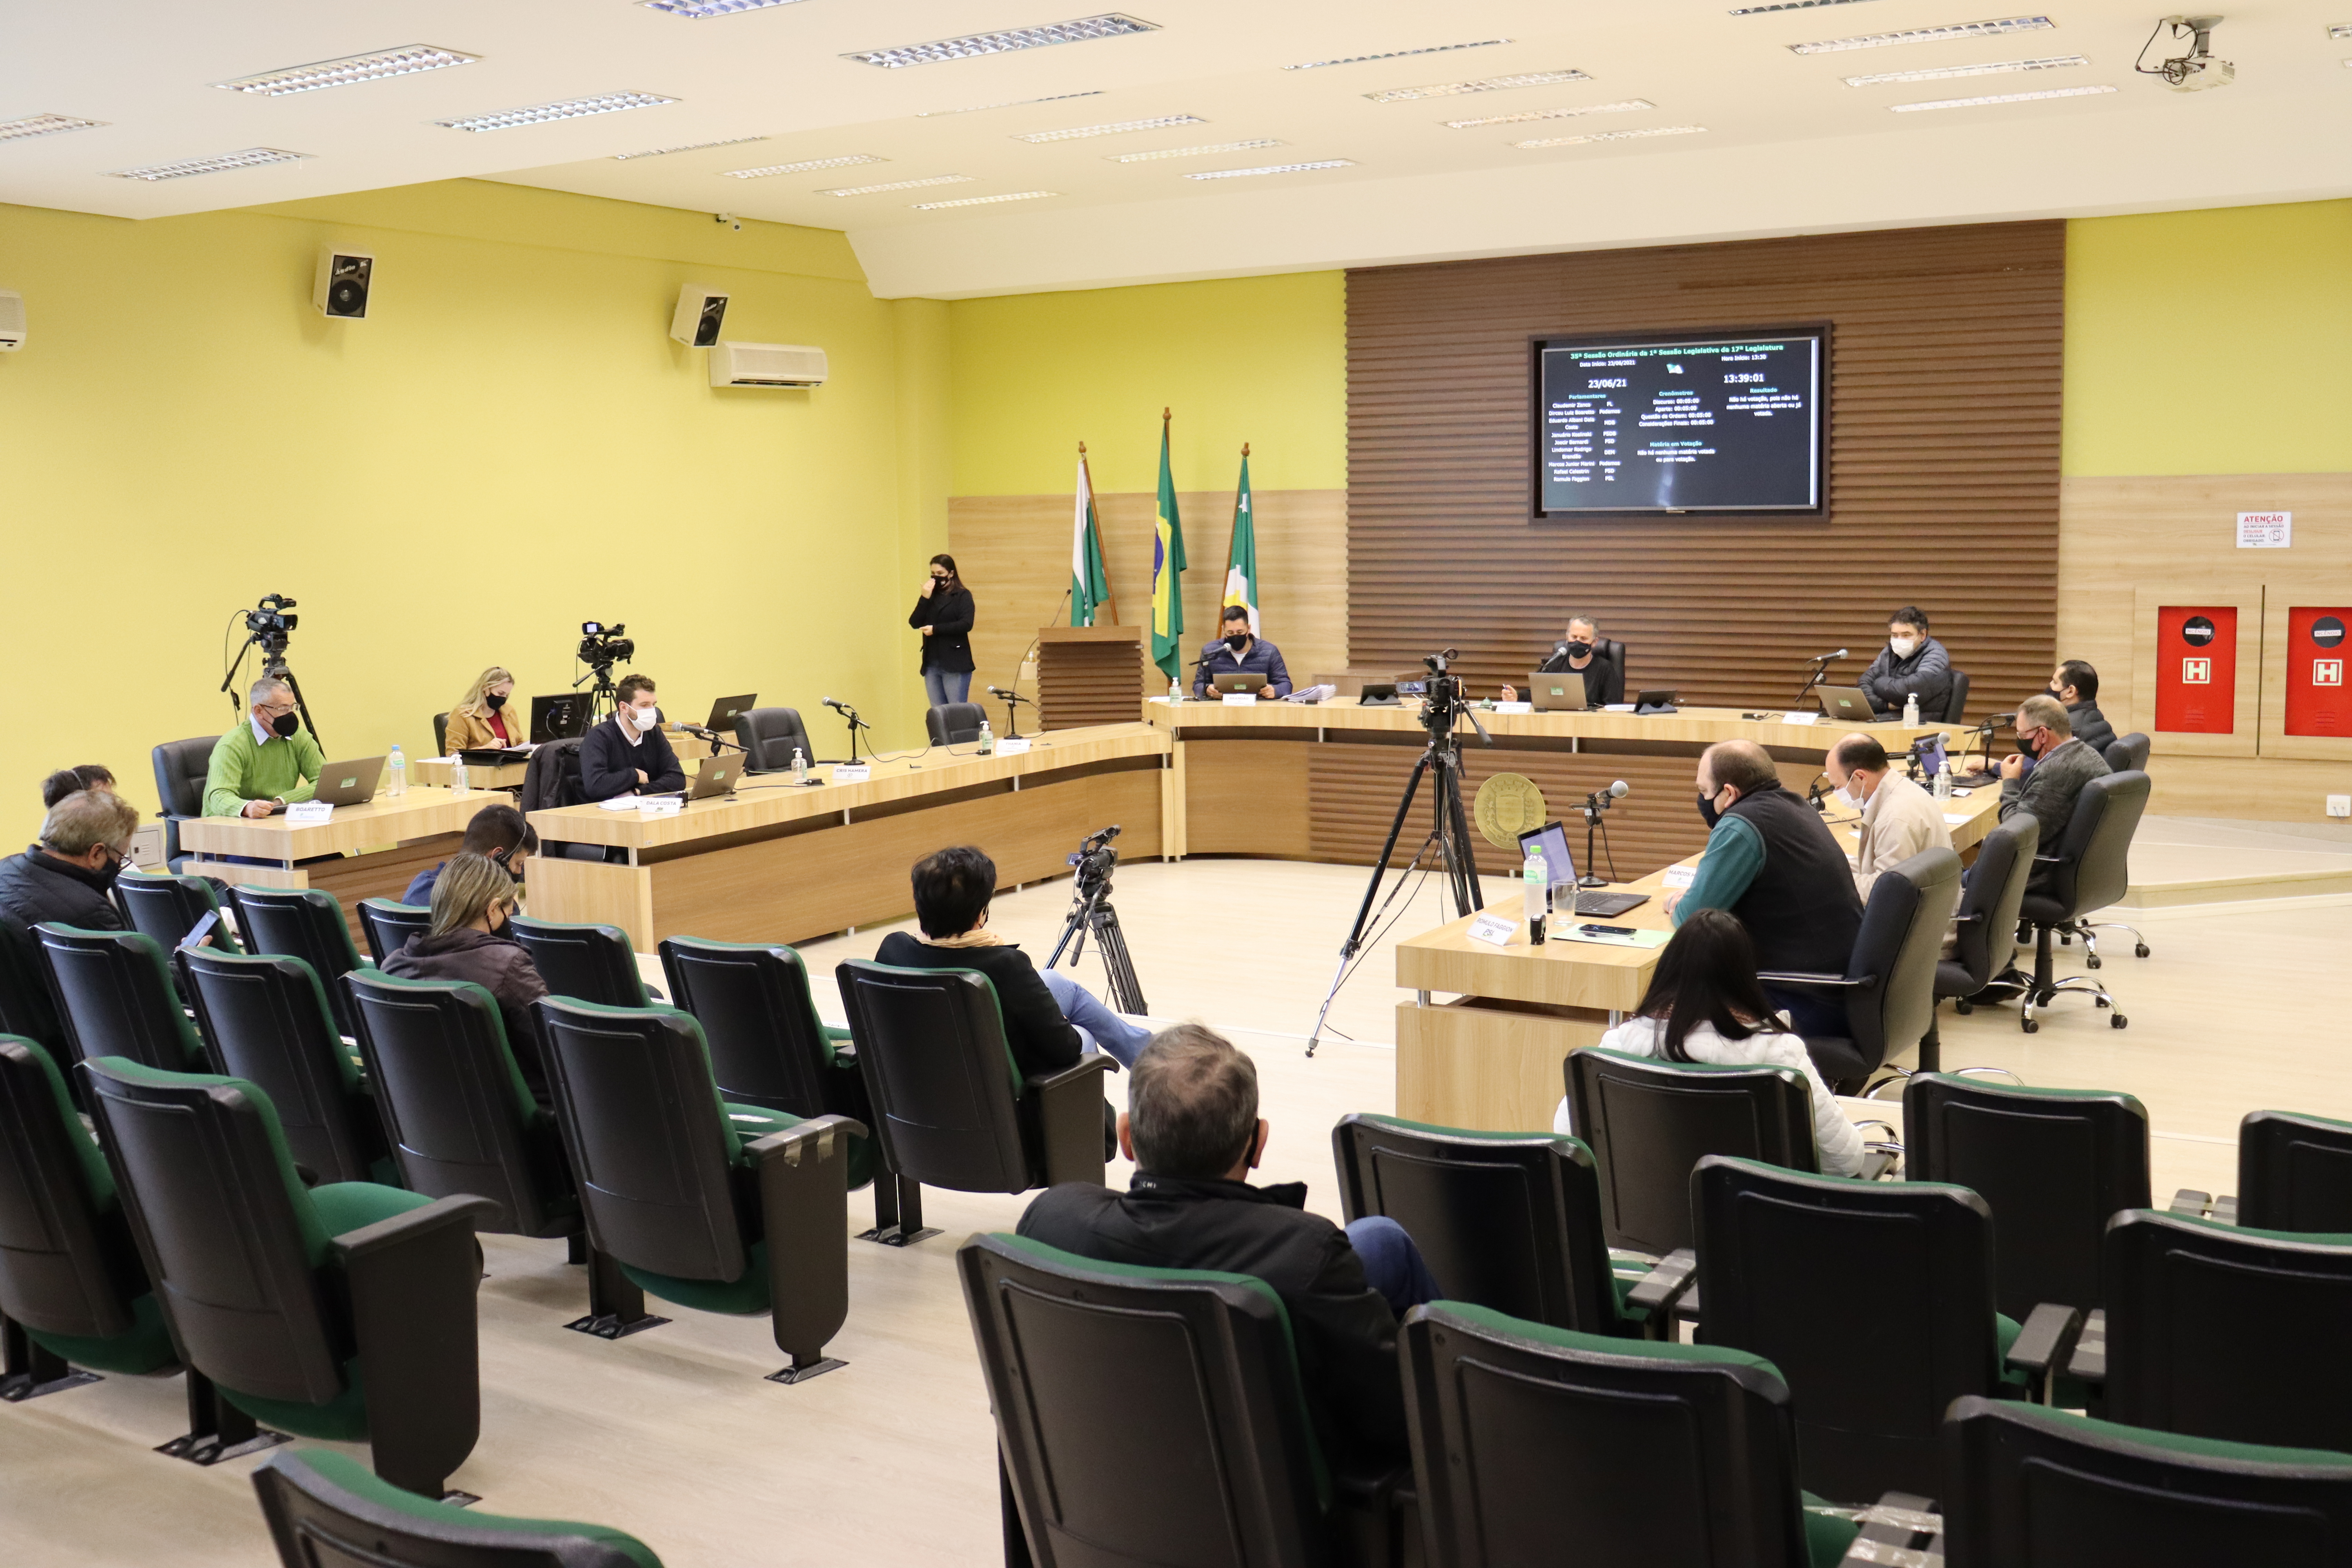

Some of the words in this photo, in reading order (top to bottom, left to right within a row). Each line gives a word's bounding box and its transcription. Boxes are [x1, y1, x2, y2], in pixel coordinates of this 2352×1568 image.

[1588, 379, 1627, 388] 23/06/21
[1724, 374, 1764, 383] 13:39:01
[2244, 514, 2283, 524] ATENÇÃO
[2187, 662, 2206, 680] H
[2318, 663, 2337, 681] H
[1477, 918, 1495, 927] ROMULO
[1493, 923, 1513, 933] FAGGION
